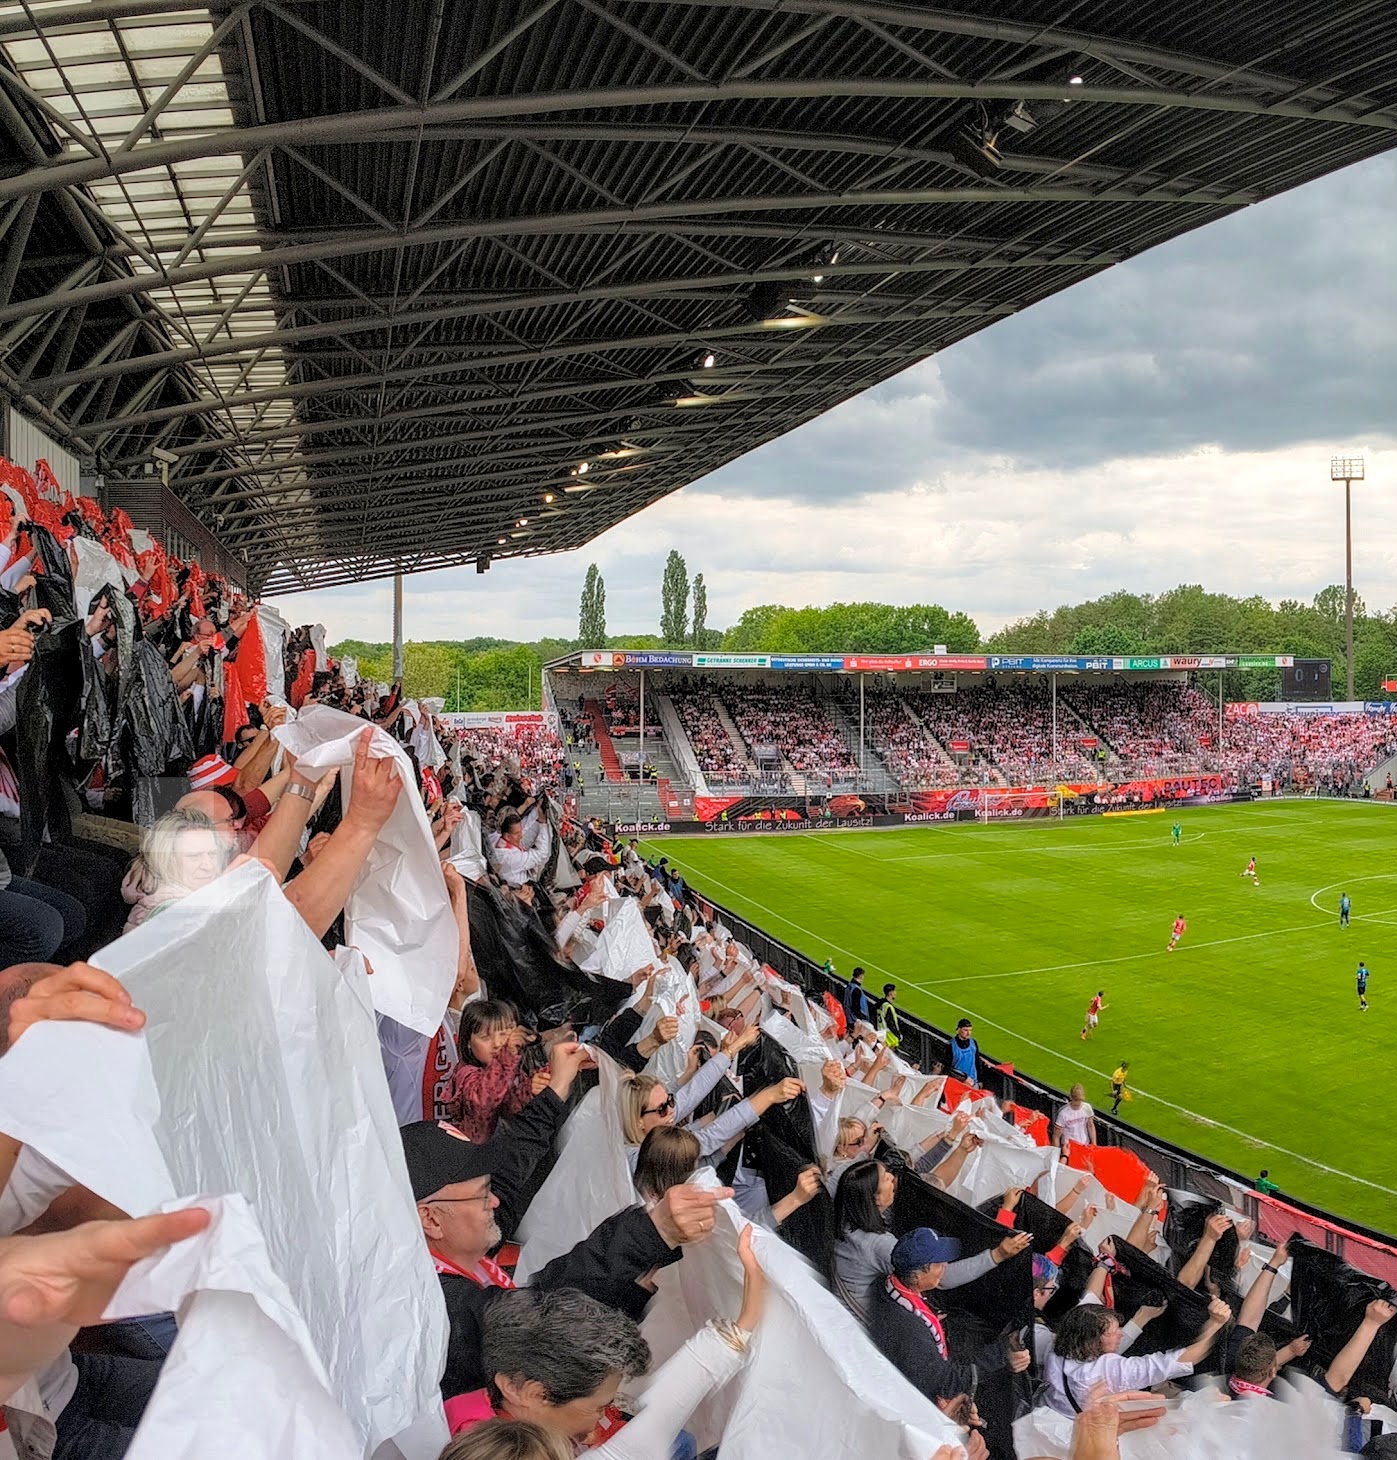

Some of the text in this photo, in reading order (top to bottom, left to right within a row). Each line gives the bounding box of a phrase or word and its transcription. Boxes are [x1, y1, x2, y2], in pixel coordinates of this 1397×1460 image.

[649, 654, 691, 664] BEDACHUNG
[1132, 659, 1158, 668] ARCUS
[1173, 657, 1202, 668] waury
[1086, 661, 1107, 669] PBIT
[974, 807, 1023, 818] Koalick.de
[1077, 804, 1090, 815] für
[1091, 804, 1105, 814] die
[1106, 803, 1136, 813] Zukunft
[1138, 802, 1152, 811] der
[904, 811, 955, 822] Koalick.de
[704, 816, 874, 832] Stark für die Zukunft der Lausitz!
